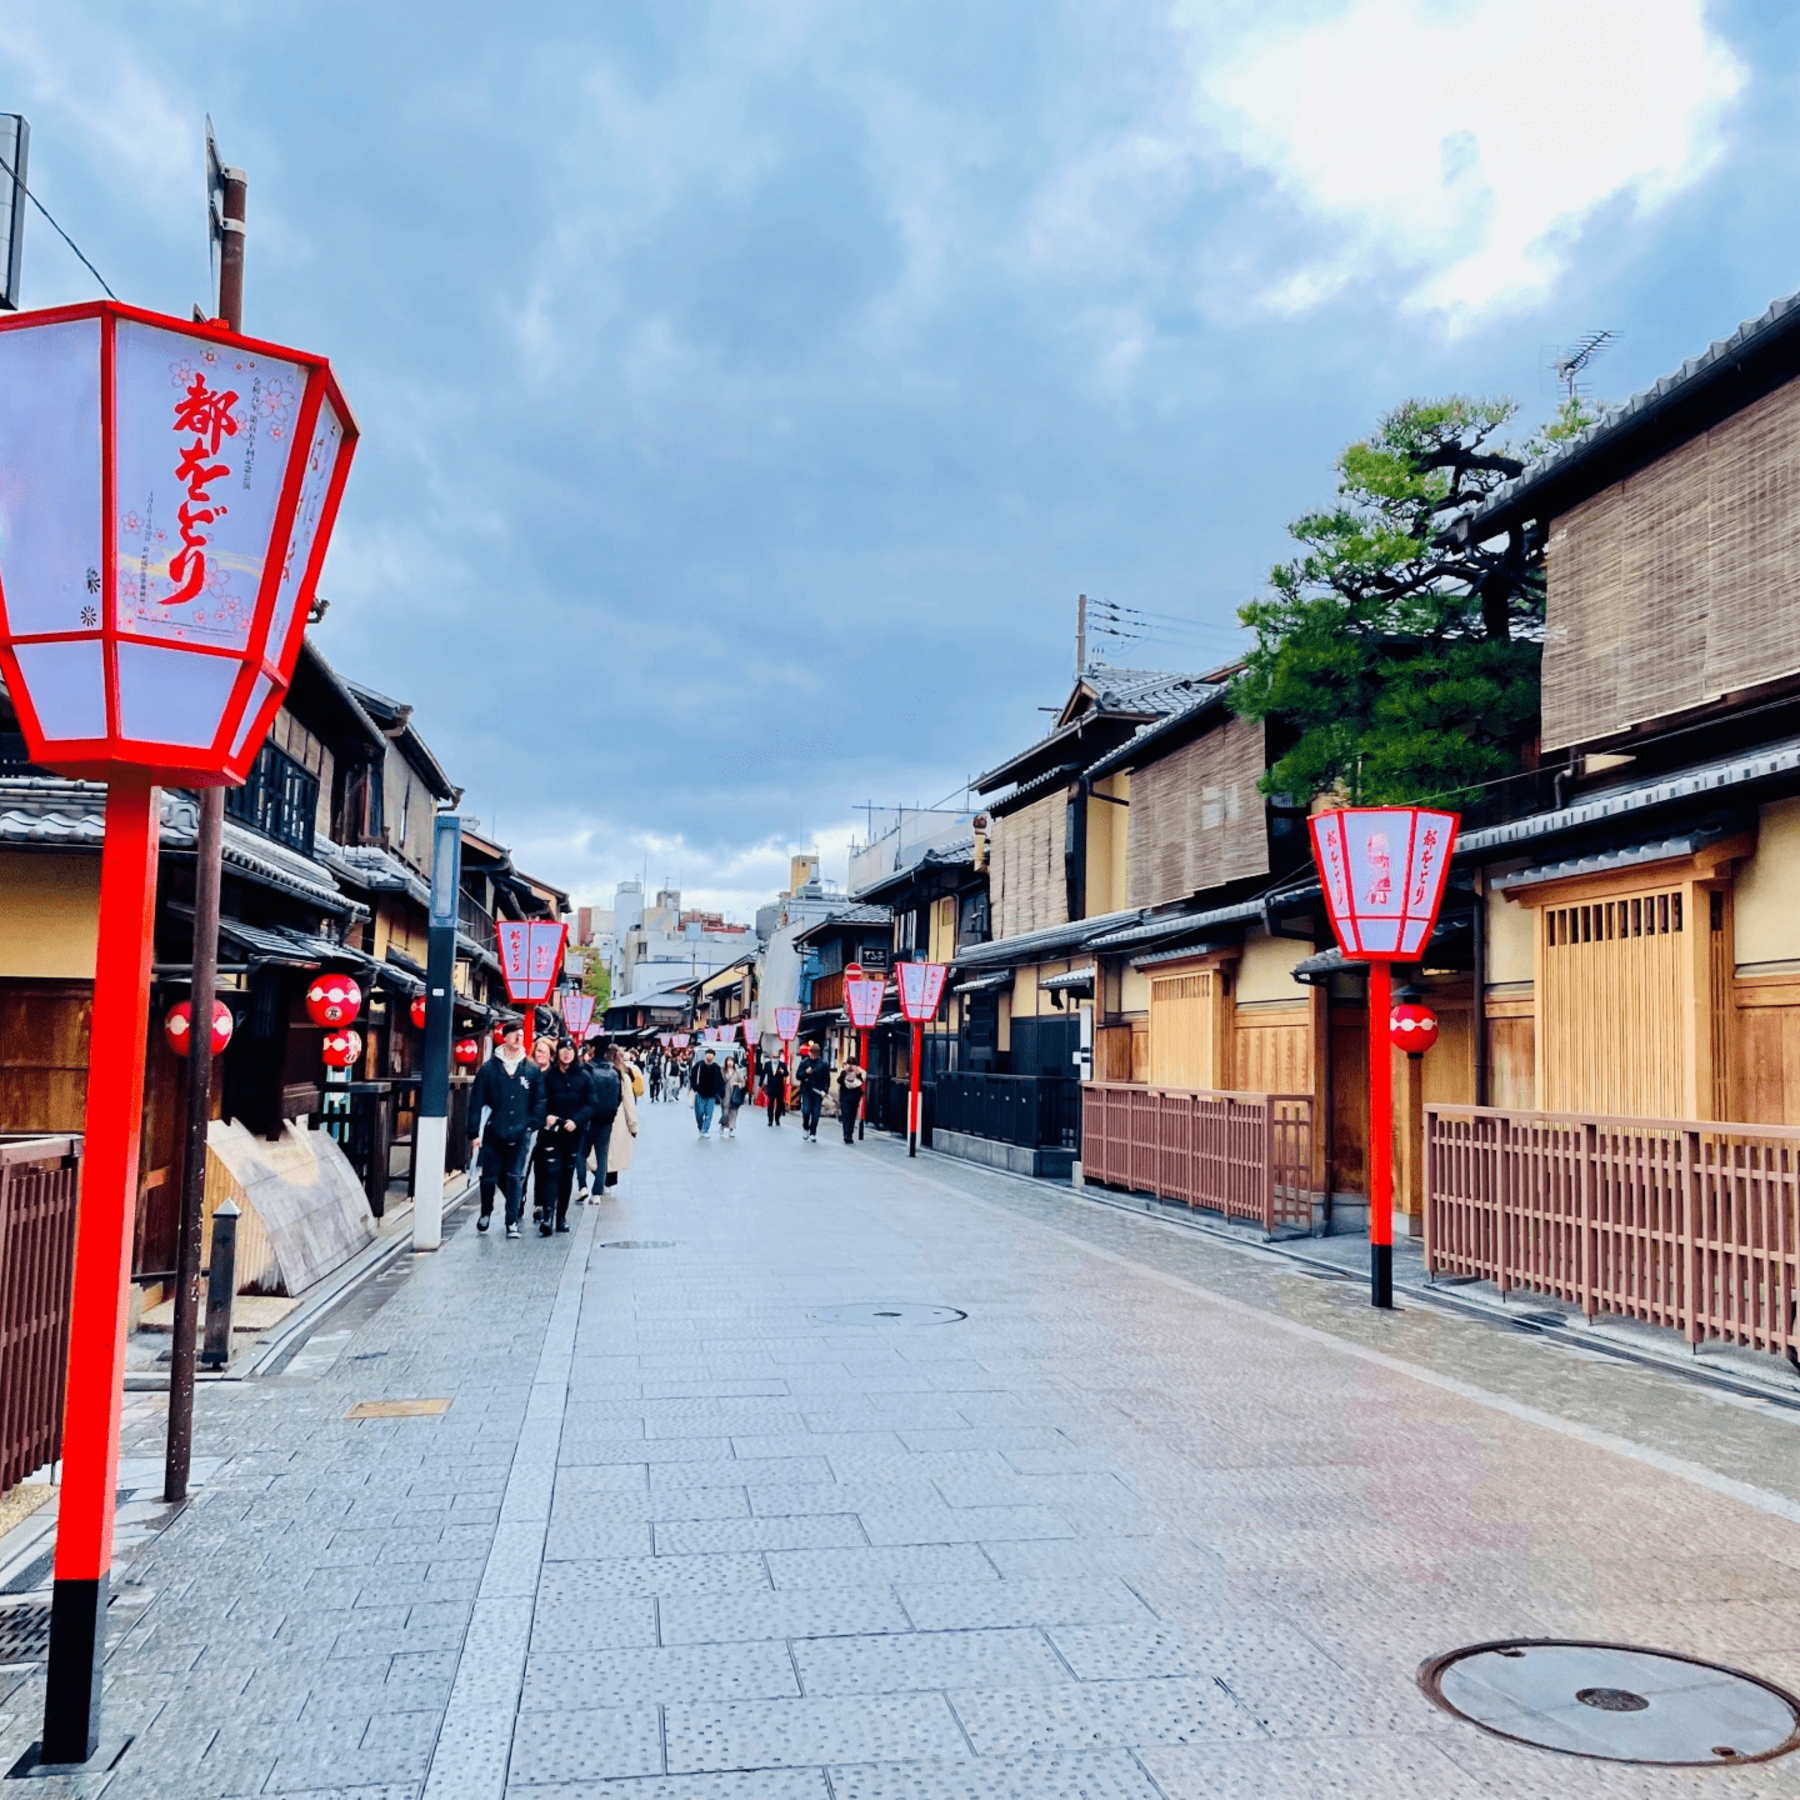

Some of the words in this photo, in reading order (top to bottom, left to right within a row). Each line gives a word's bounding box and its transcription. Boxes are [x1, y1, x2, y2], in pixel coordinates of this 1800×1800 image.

[157, 372, 240, 605] 都をどり
[1413, 826, 1438, 906] 都をどり
